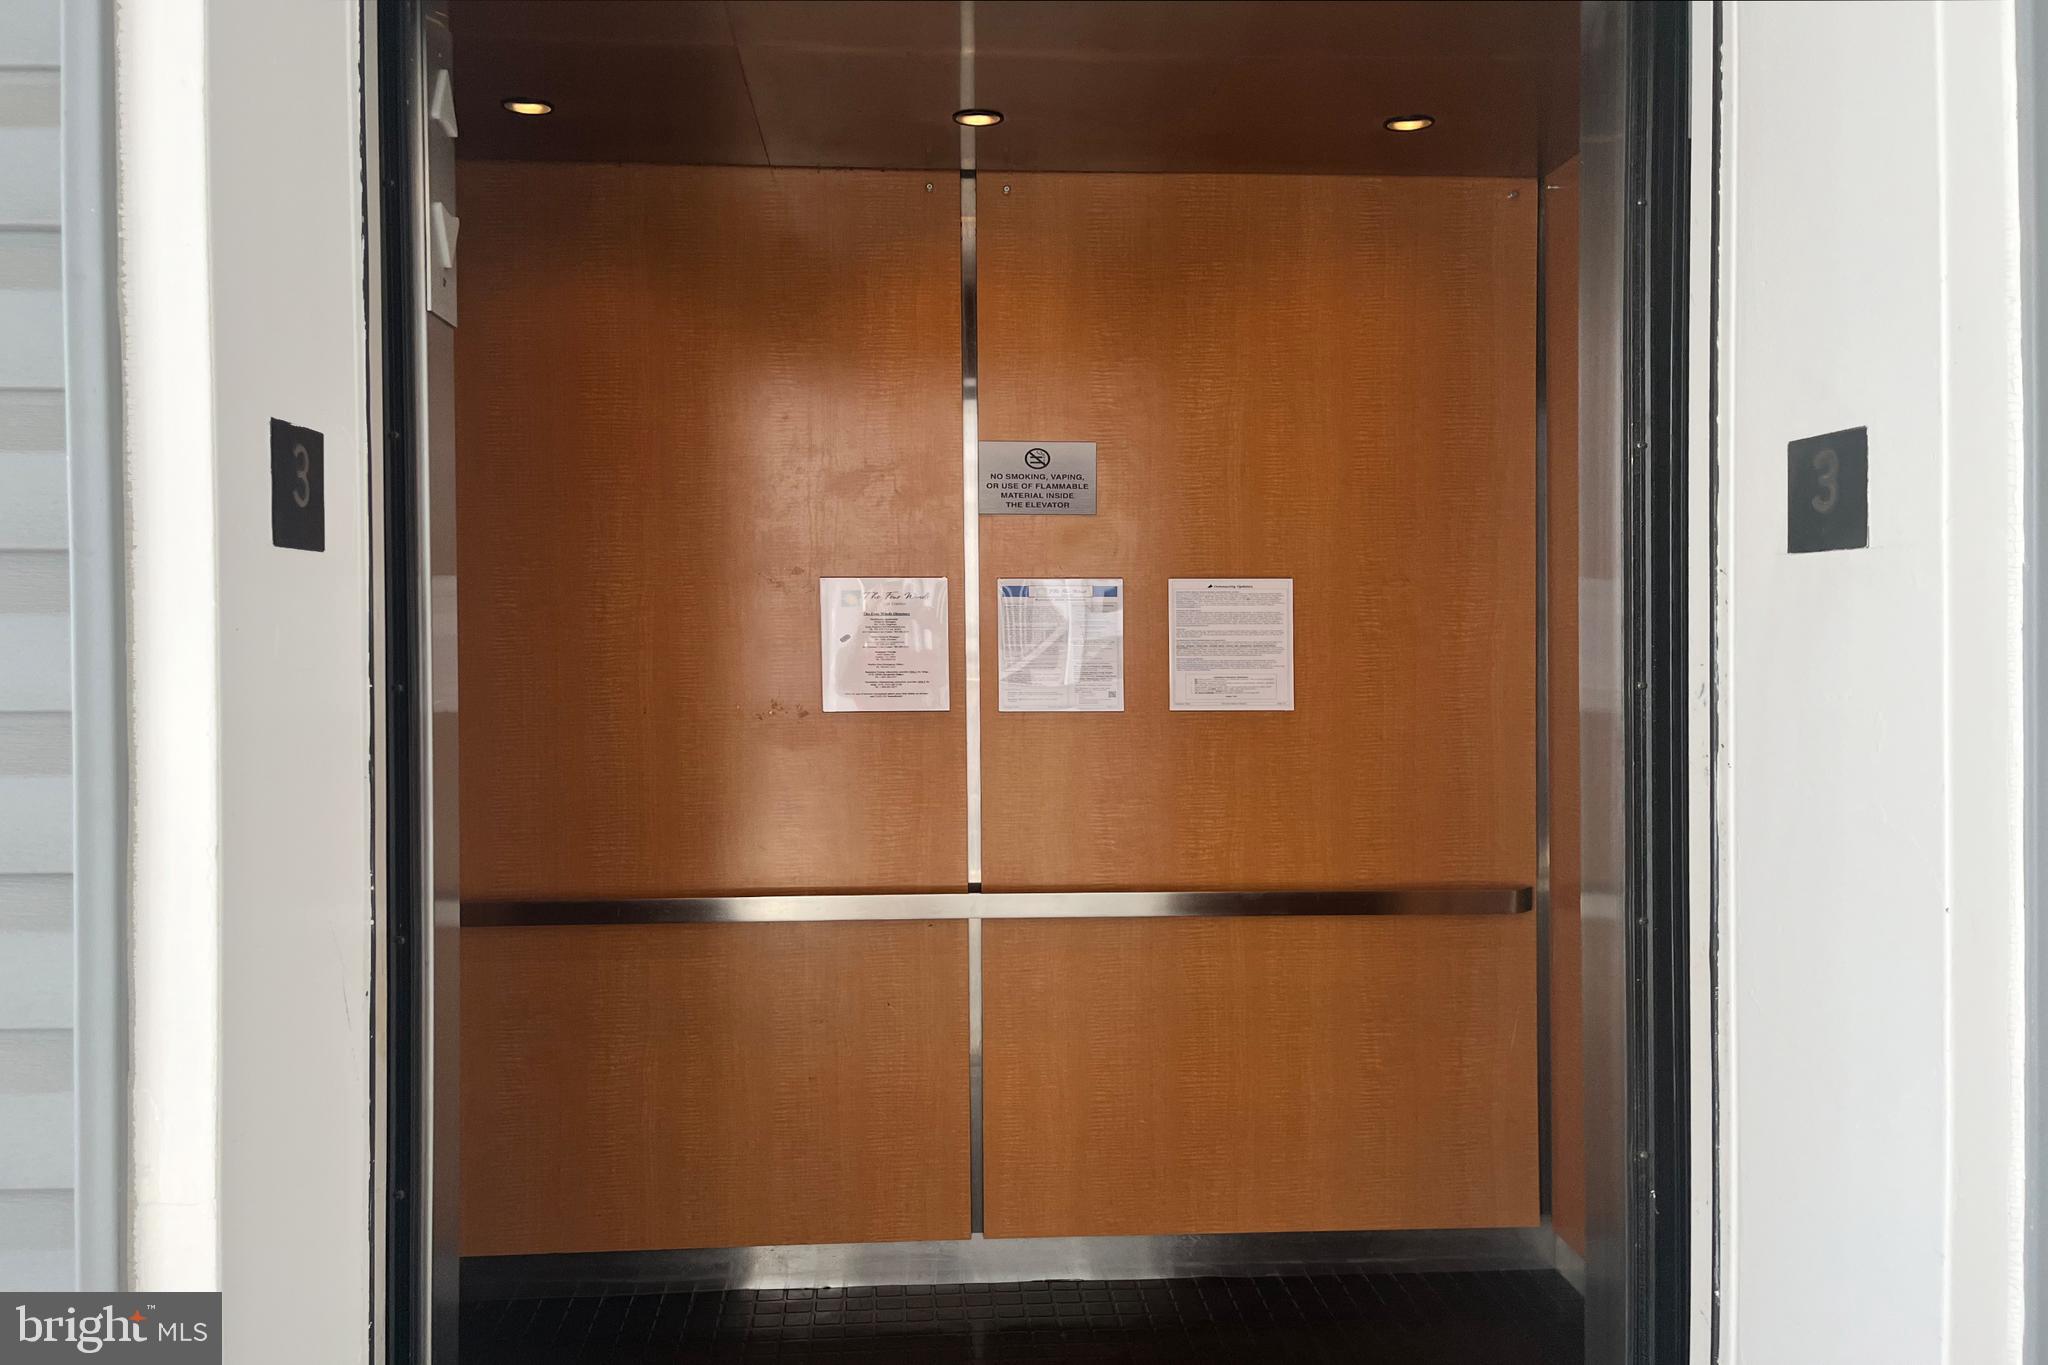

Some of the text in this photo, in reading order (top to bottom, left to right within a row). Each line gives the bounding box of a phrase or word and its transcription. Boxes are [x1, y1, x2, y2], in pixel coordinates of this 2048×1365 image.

[293, 443, 310, 508] 3
[986, 482, 999, 490] OR
[1001, 482, 1018, 490] USE
[1021, 482, 1033, 490] OF
[1005, 473, 1048, 481] SMOKING,
[1050, 473, 1085, 481] VAPING,
[1812, 448, 1838, 513] 3
